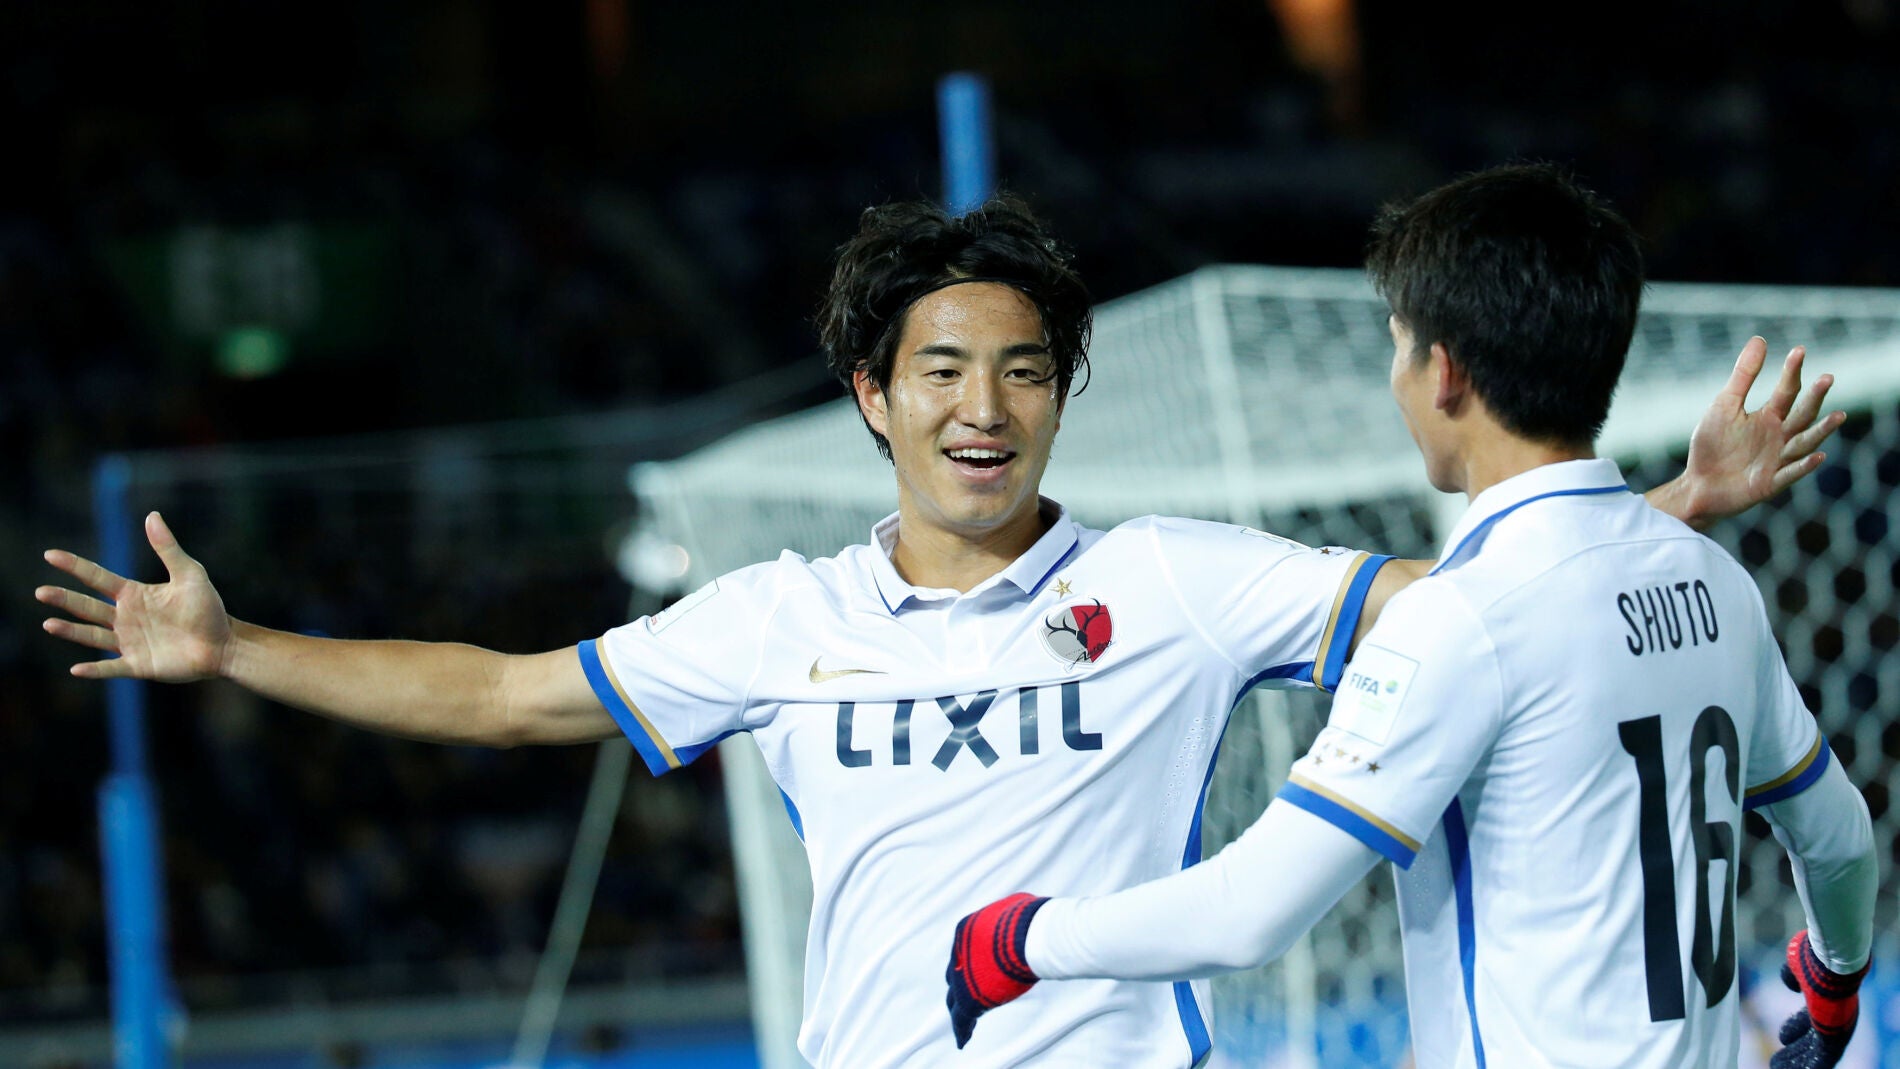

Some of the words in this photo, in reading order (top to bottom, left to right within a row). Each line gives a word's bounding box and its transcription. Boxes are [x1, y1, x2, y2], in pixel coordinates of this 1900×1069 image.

[1617, 578, 1719, 656] SHUTO
[836, 680, 1103, 773] LIXIL
[1349, 672, 1380, 696] FIFA
[1618, 705, 1740, 1022] 16
